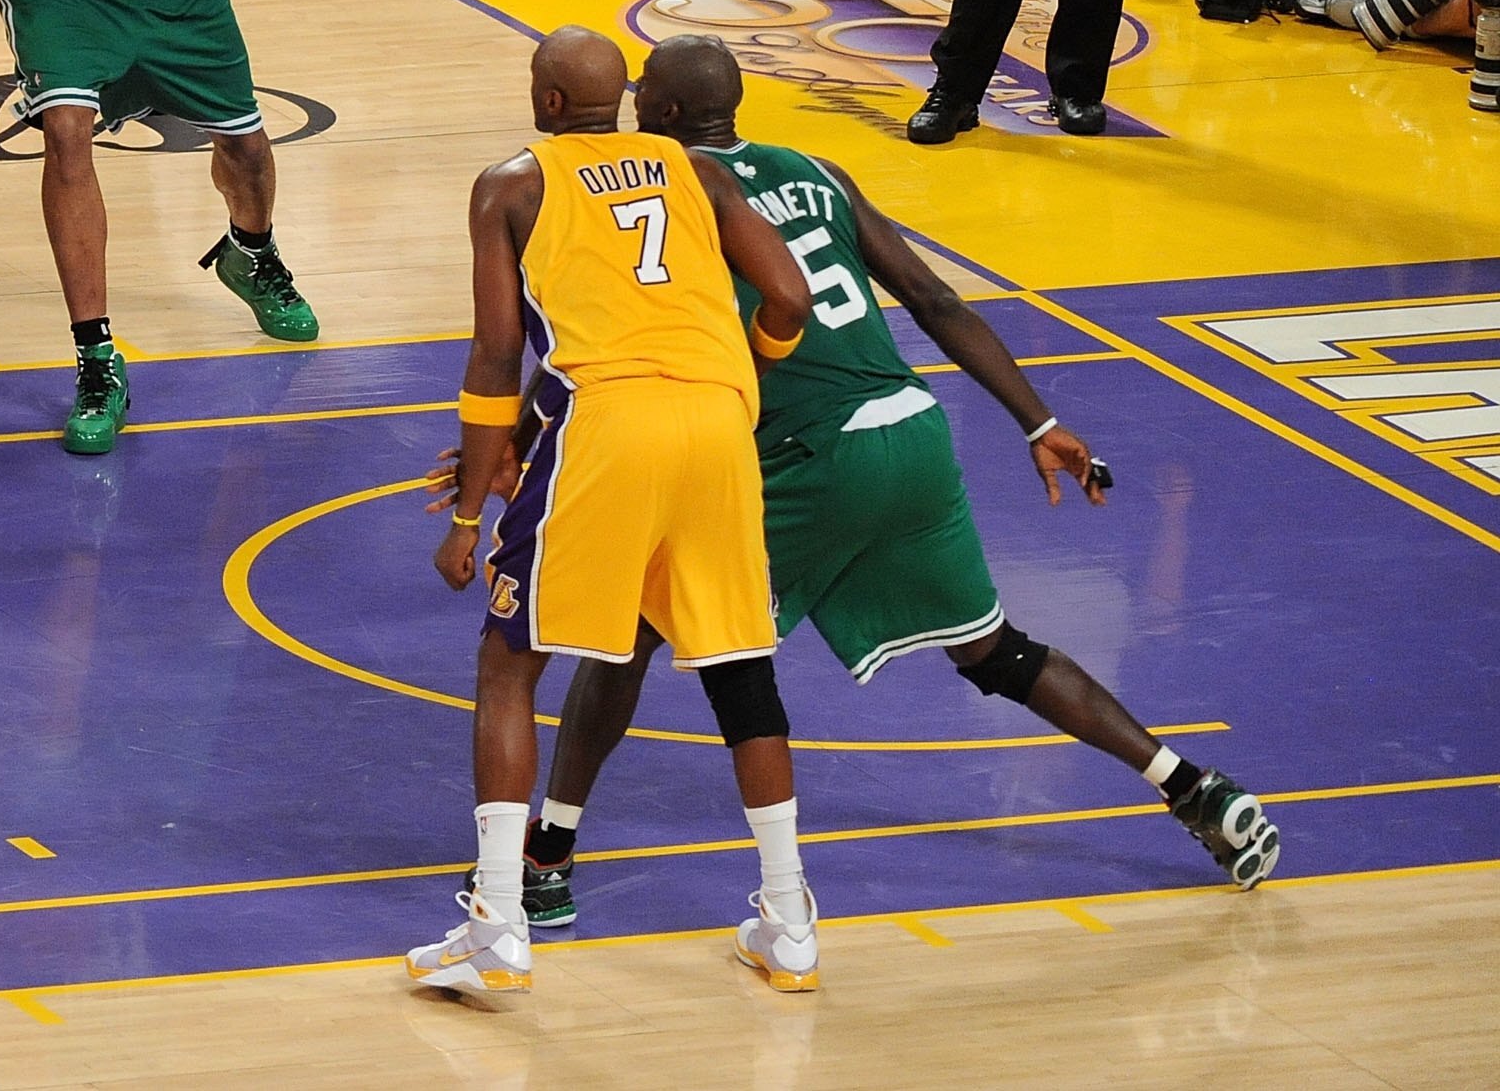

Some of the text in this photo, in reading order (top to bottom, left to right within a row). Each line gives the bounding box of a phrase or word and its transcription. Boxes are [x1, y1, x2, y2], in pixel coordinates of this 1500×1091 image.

[577, 158, 669, 196] ODOM
[746, 180, 836, 227] RNETT
[609, 194, 672, 286] 7
[785, 225, 868, 331] 5
